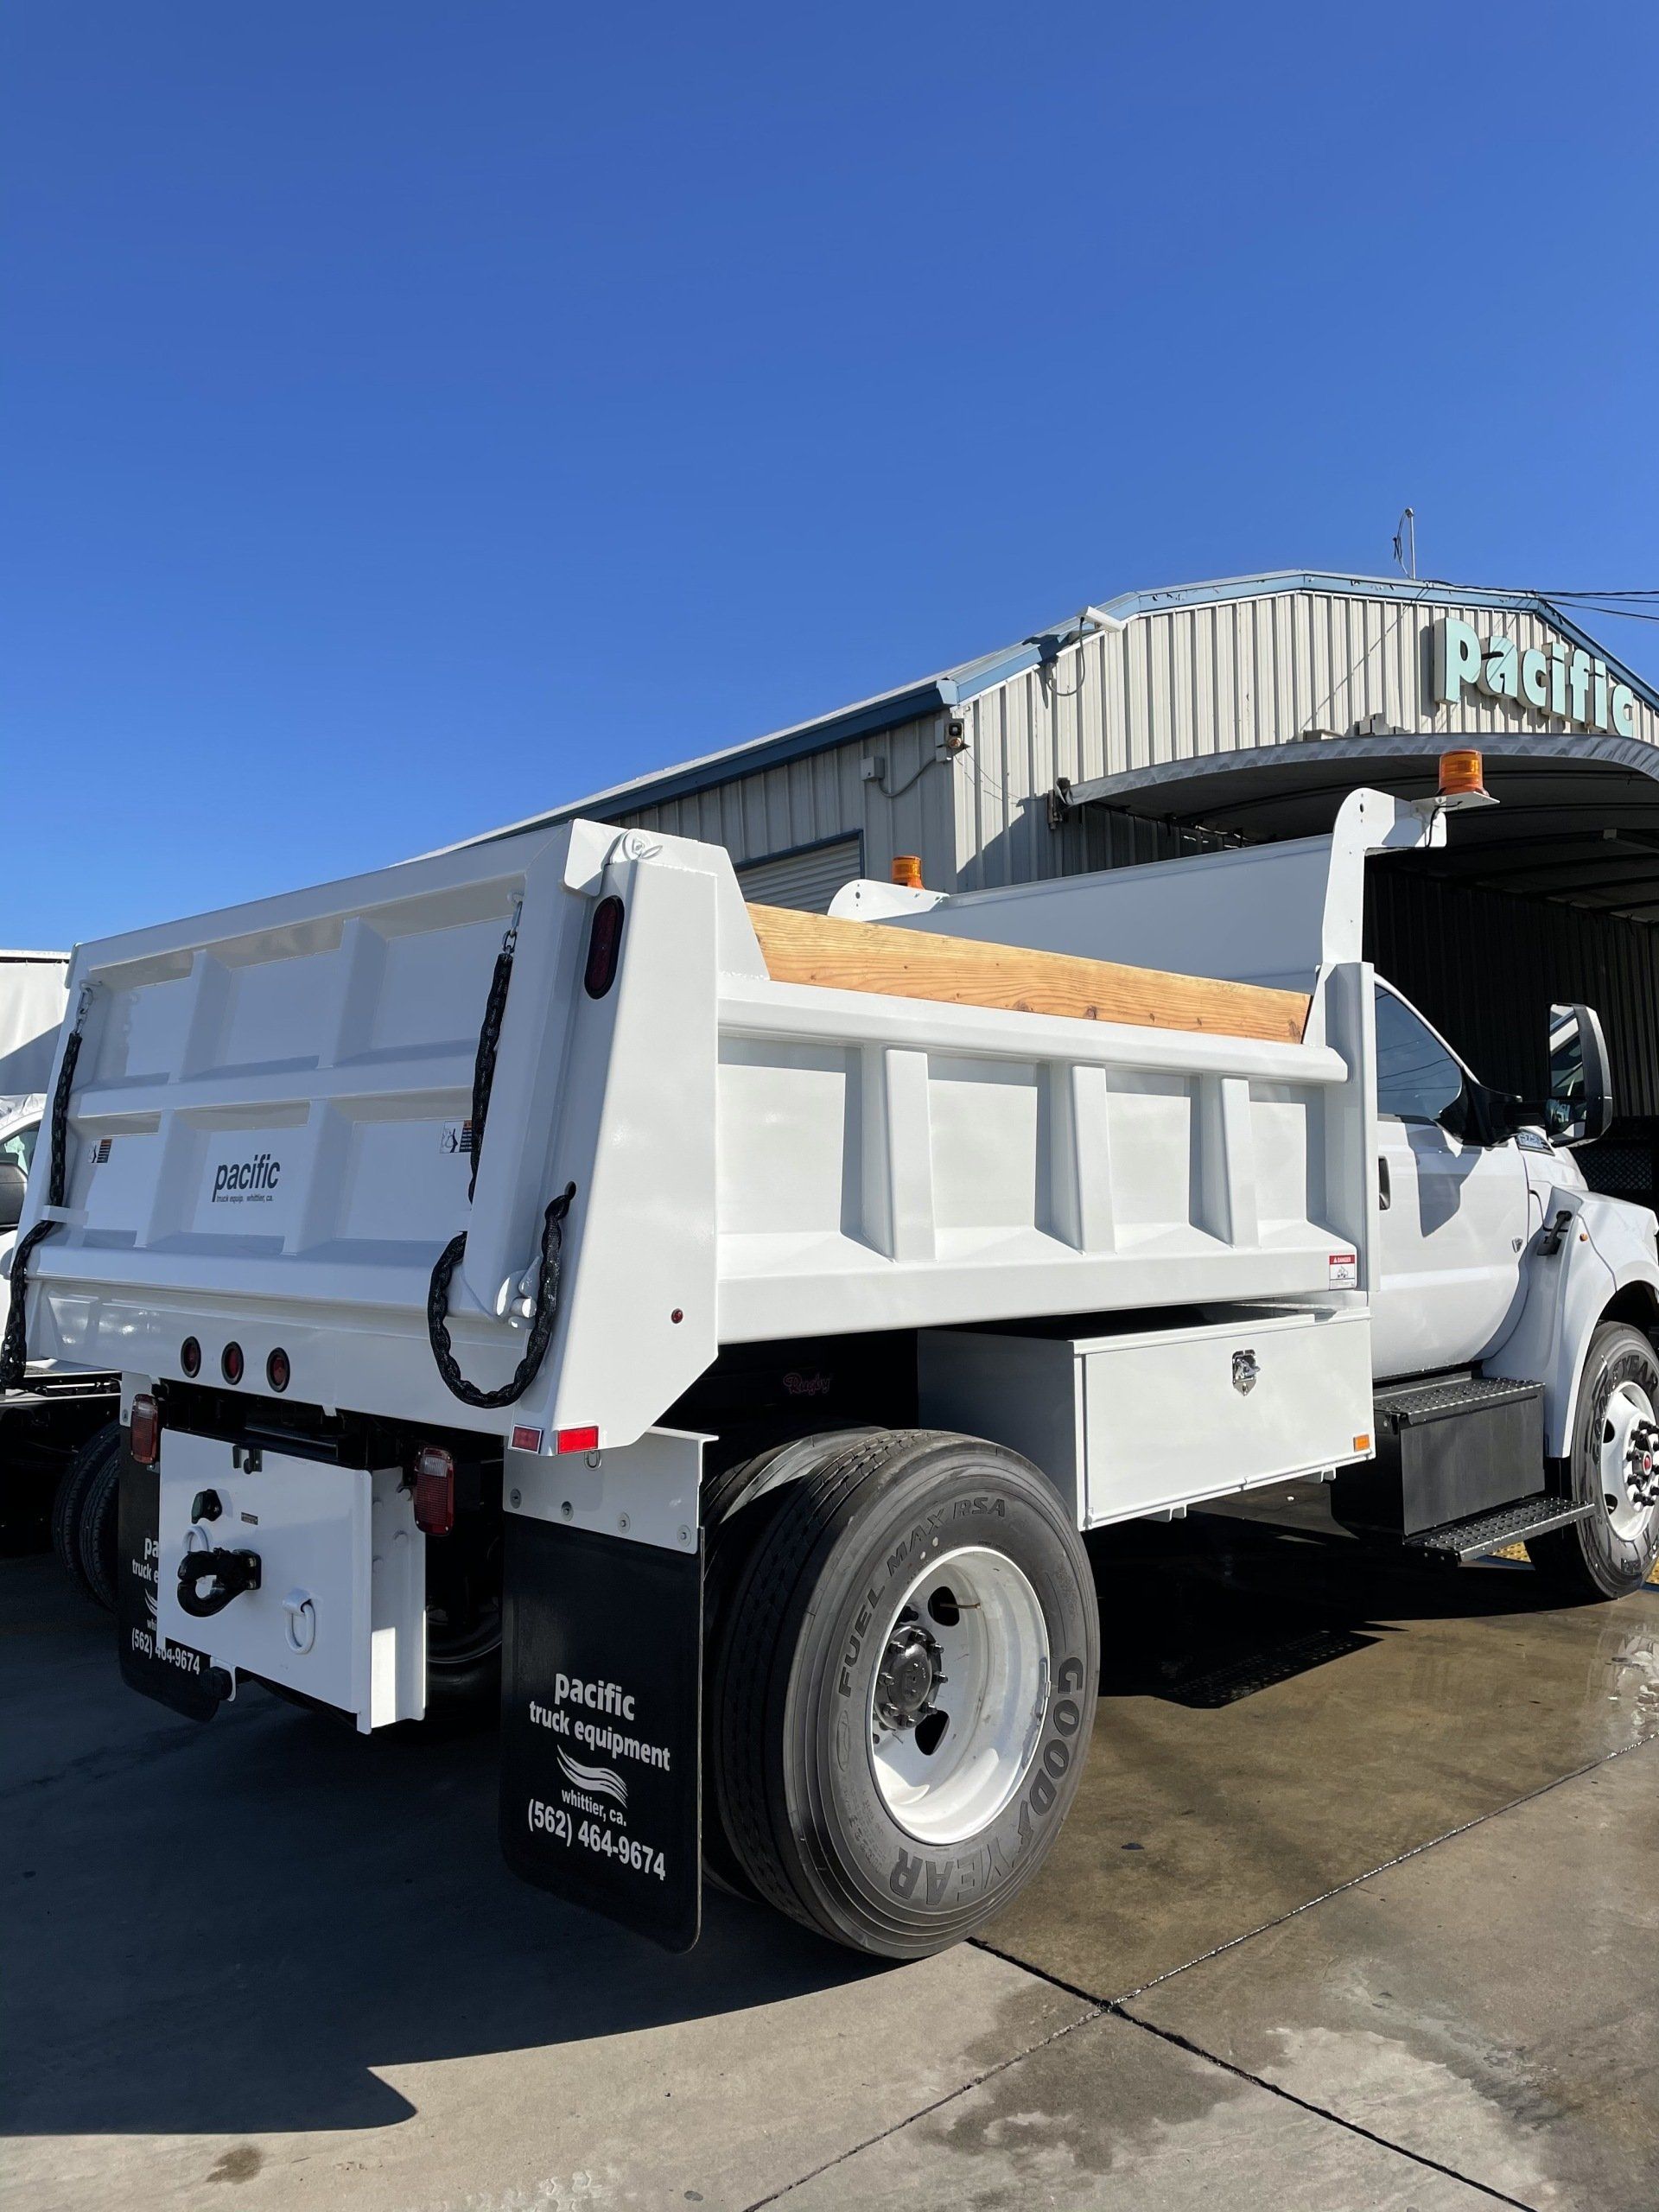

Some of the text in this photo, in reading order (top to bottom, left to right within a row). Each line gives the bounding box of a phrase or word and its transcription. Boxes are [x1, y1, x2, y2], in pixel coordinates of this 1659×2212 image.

[1438, 617, 1632, 738] Pacific
[212, 1154, 280, 1202] pacific
[783, 1371, 832, 1395] Rugby
[131, 1558, 152, 1580] truck
[838, 1586, 886, 1698] FUEL
[886, 1508, 948, 1577] MAX
[953, 1497, 1006, 1520] RSA
[131, 1627, 153, 1660] (562)
[554, 1673, 635, 1721] pacific
[529, 1700, 671, 1771] truck equipment
[889, 1657, 1084, 1905] GOODYEAR
[562, 1789, 627, 1827] whittier, ca.
[528, 1798, 666, 1881] (562) 464-9674
